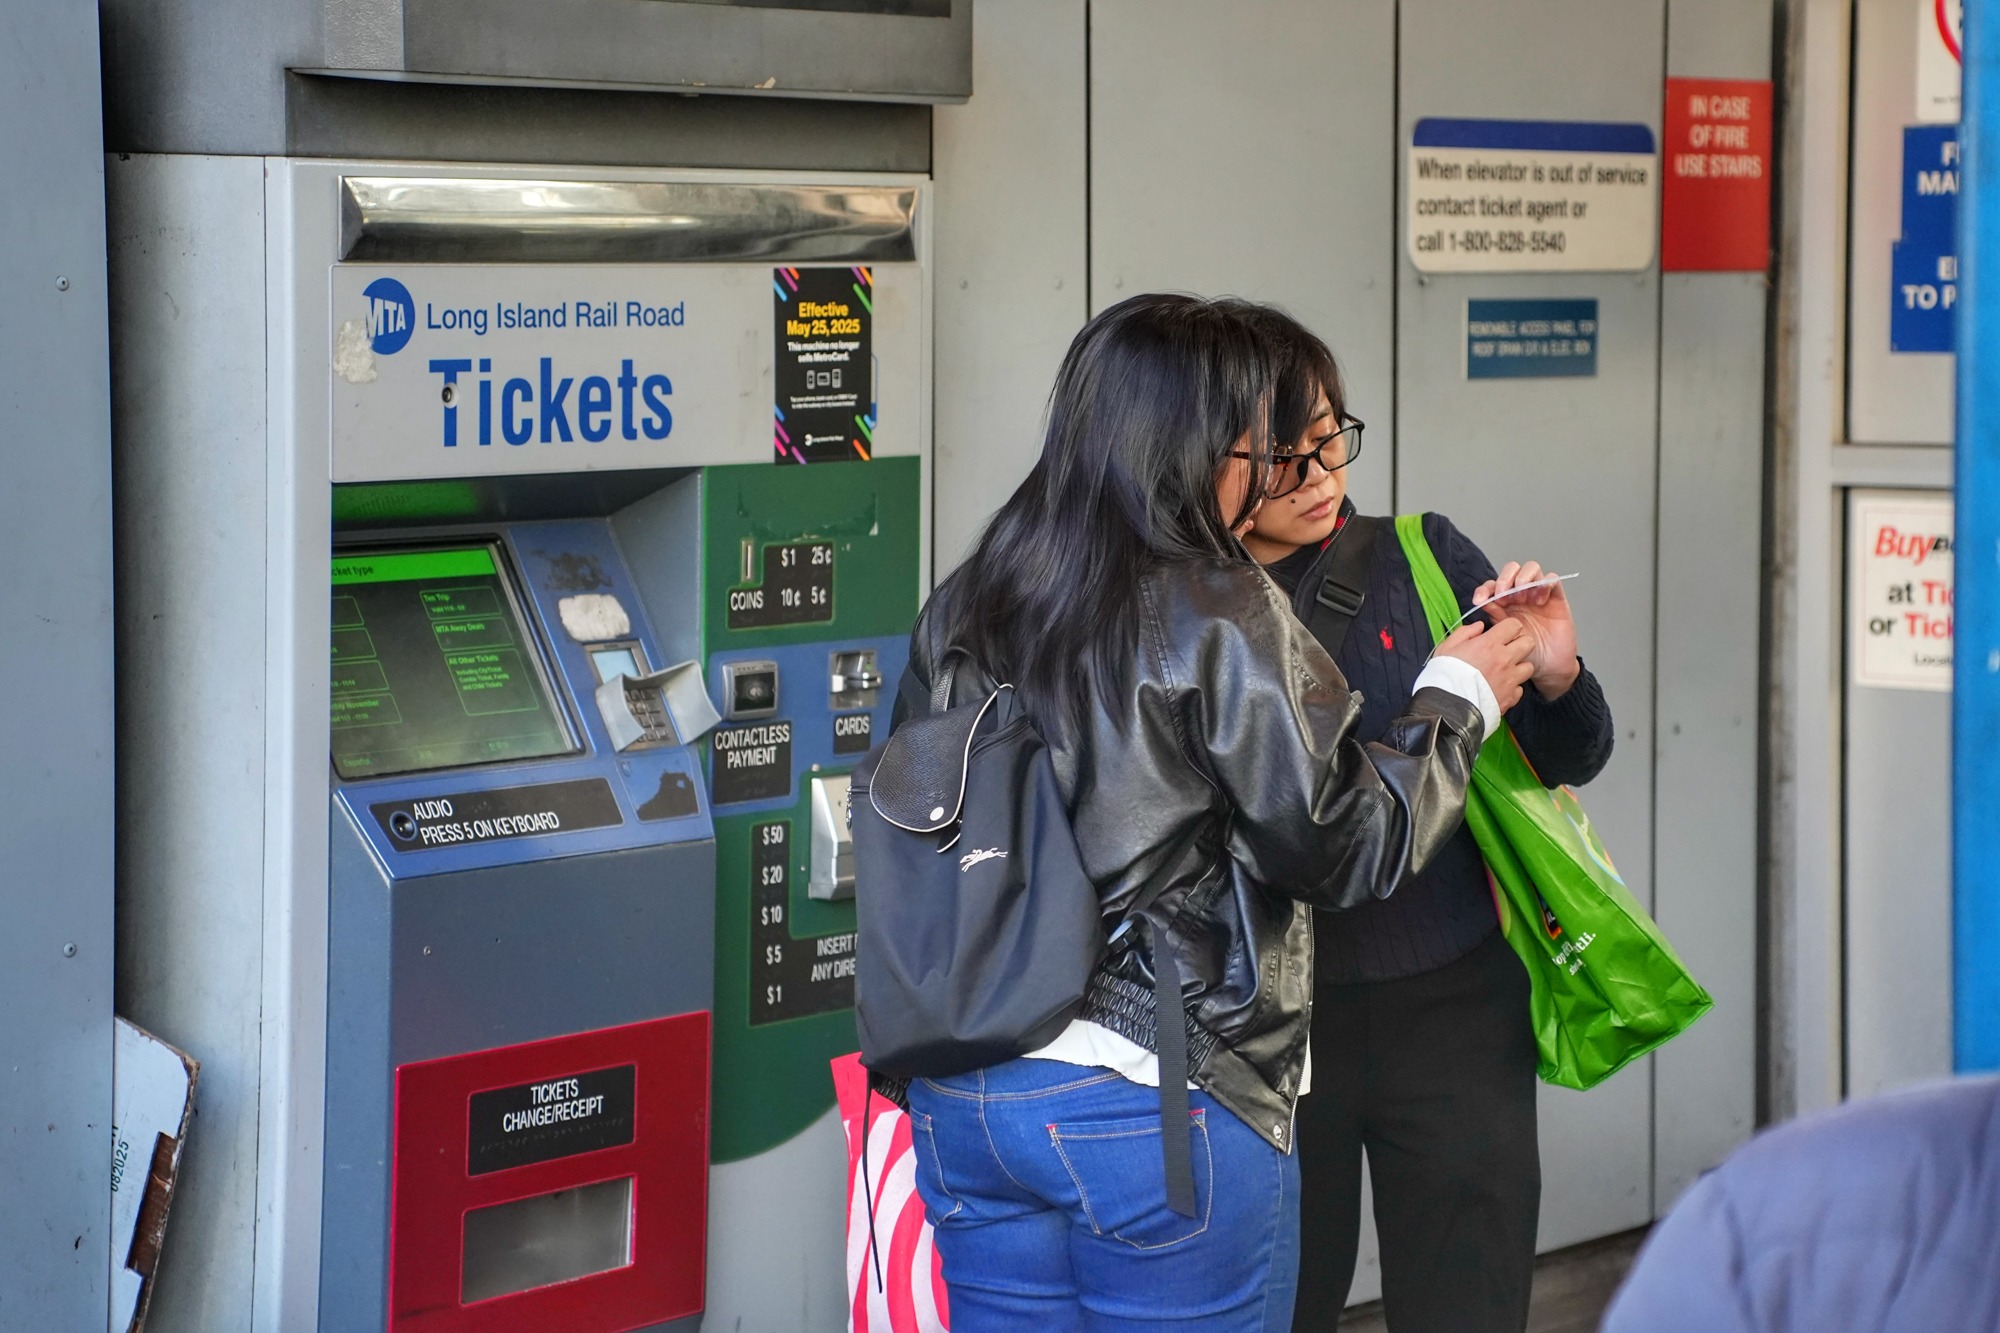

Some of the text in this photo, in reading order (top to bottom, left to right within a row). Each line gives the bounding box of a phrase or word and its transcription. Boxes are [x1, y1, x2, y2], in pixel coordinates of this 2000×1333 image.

[1690, 95, 1751, 120] IN CASE
[1690, 124, 1749, 149] OF FIRE
[1417, 158, 1648, 185] When elevator is out of service
[1674, 153, 1762, 178] USE STAIRS
[1918, 170, 1959, 195] MA
[1417, 196, 1587, 222] contact ticket agent or
[1417, 229, 1444, 252] call
[1938, 256, 1957, 280] E
[1902, 284, 1957, 310] TO P
[365, 295, 406, 338] MTA
[427, 300, 685, 336] Long Island Rail Road
[798, 301, 849, 318] Effective
[786, 318, 861, 338] May 25, 2025
[429, 357, 673, 447] Tickets
[811, 546, 832, 565] 25¢
[1874, 525, 1936, 566] Buy
[352, 565, 374, 577] type
[731, 590, 764, 611] COINS
[781, 586, 826, 607] 10¢ 5¢
[1888, 582, 1914, 604] at
[1869, 616, 1898, 636] or
[715, 724, 790, 751] CONTACTLESS
[835, 716, 869, 736] CARDS
[727, 746, 777, 769] PAYMENT
[413, 799, 453, 820] AUDIO
[420, 812, 560, 845] PRESS 5 ON KEYBOARD
[762, 825, 784, 845] $50
[762, 865, 783, 886] $20
[761, 905, 782, 926] $10
[766, 945, 782, 965] $5
[817, 935, 853, 957] INSERT
[811, 962, 832, 982] ANY
[766, 985, 782, 1005] $1
[531, 1078, 579, 1105] TICKETS
[503, 1095, 604, 1133] CHANGE/RECEIPT
[111, 1141, 129, 1192] 082025
